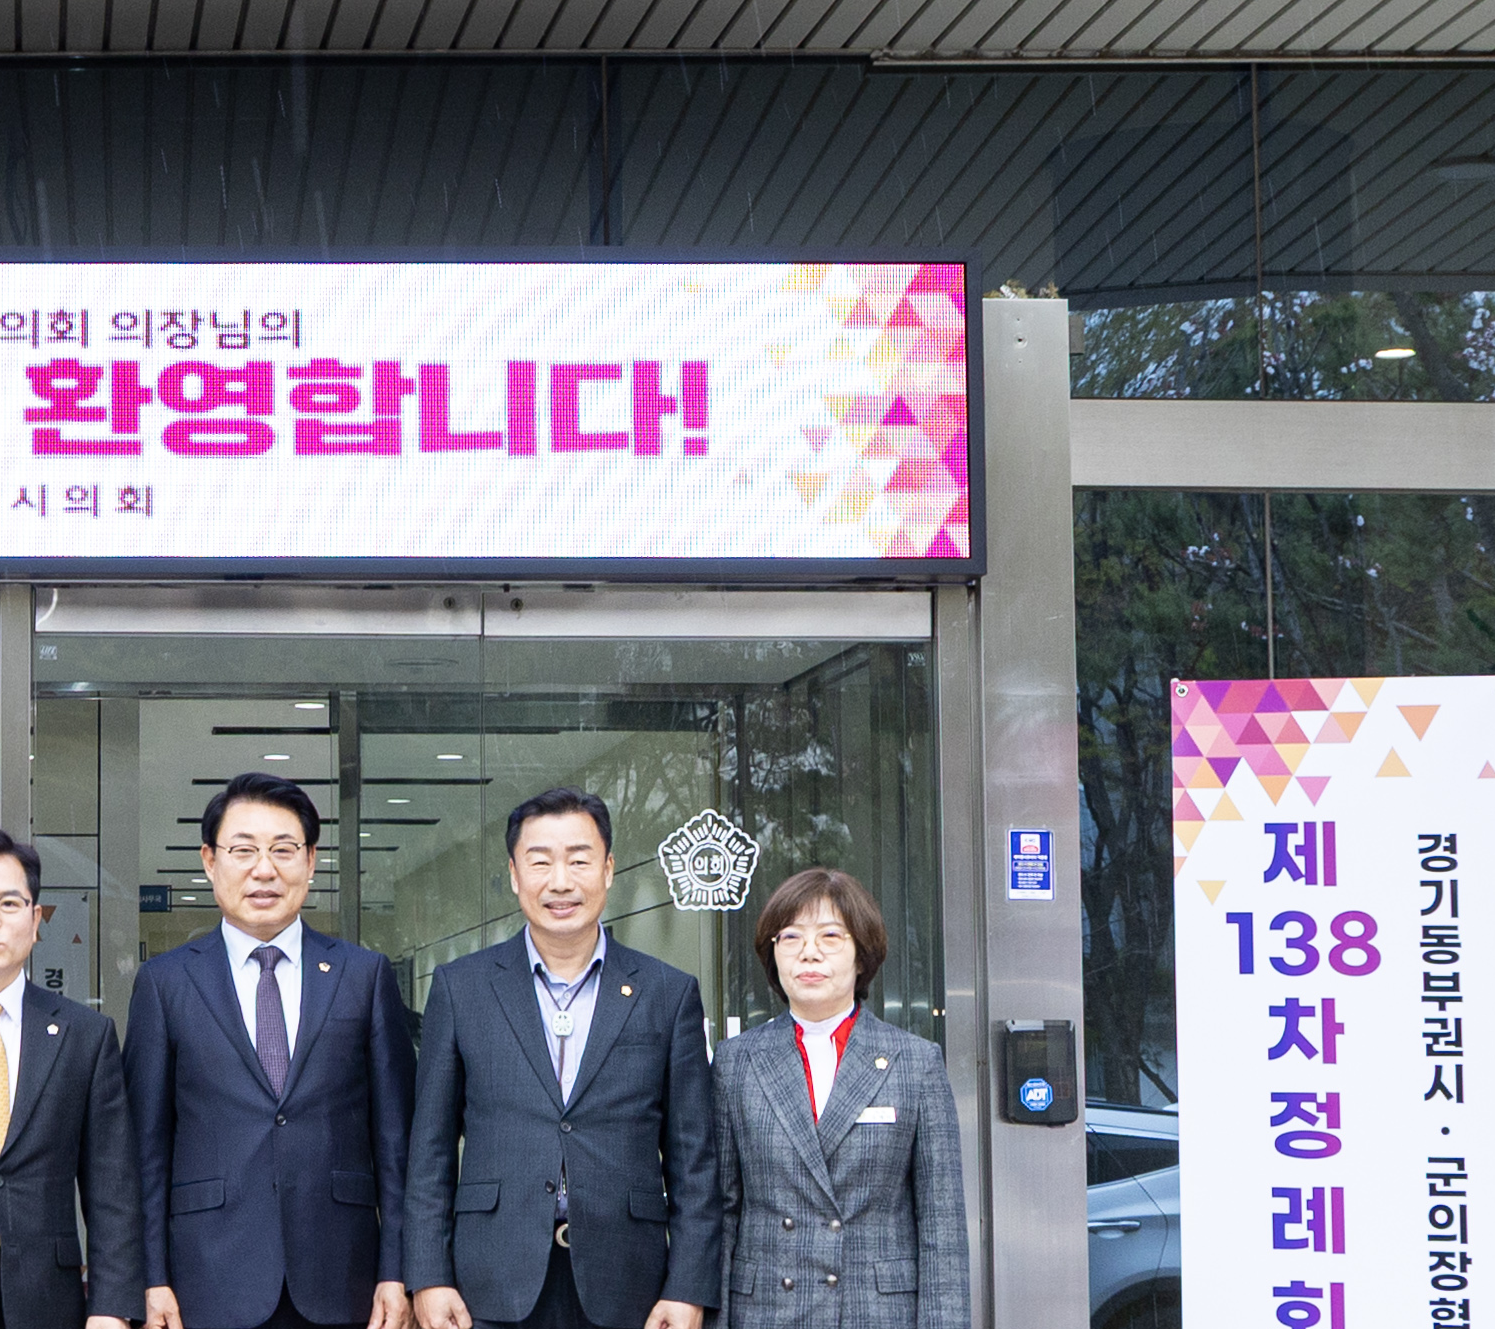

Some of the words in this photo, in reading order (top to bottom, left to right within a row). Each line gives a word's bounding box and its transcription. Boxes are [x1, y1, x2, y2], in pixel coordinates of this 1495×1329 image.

[109, 308, 302, 350] 의장님의
[23, 356, 709, 458] 환영합니다!
[694, 854, 725, 876] 의회
[1025, 1088, 1048, 1102] ADT
